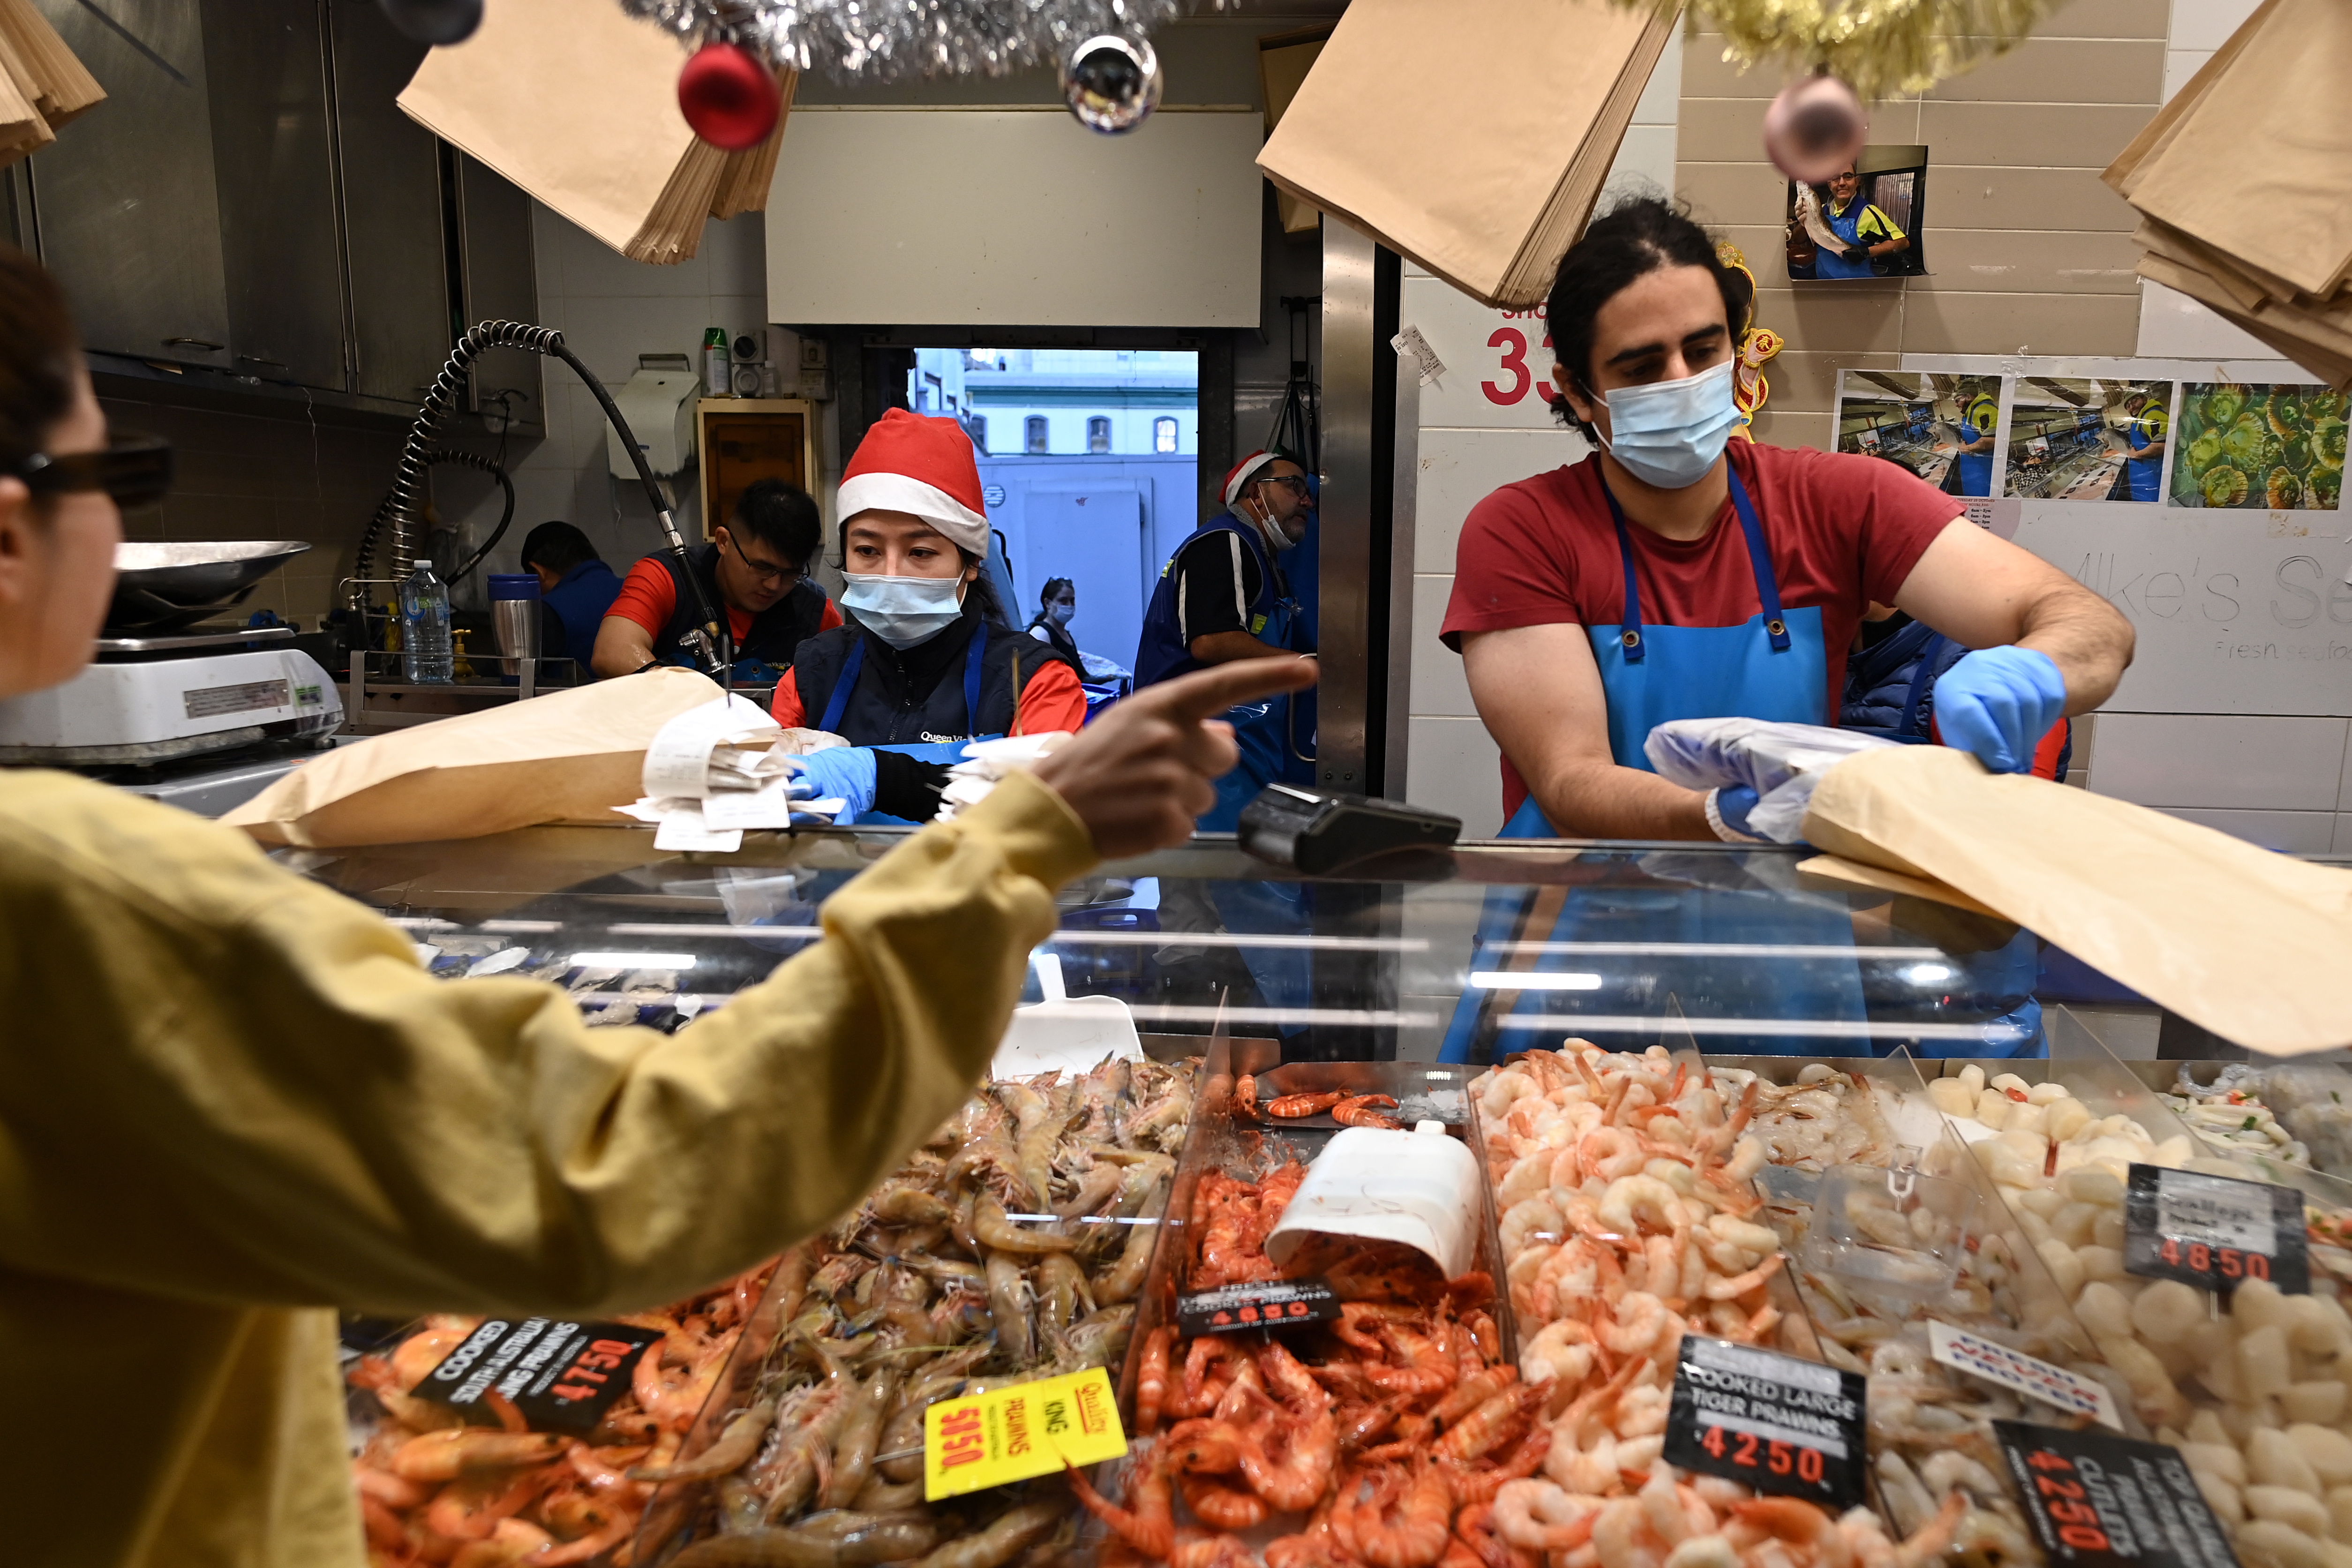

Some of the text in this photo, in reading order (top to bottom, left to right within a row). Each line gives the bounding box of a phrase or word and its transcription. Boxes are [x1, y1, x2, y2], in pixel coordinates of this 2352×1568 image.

[920, 731, 952, 742] Queen
[434, 1320, 510, 1380] COOKED
[517, 1322, 580, 1372] PRAWNS
[1044, 1399, 1069, 1435] KING
[1686, 1365, 1780, 1401] COOKED
[1783, 1387, 1856, 1421] LARGE
[1691, 1386, 1843, 1438] TIGER PRAWNS
